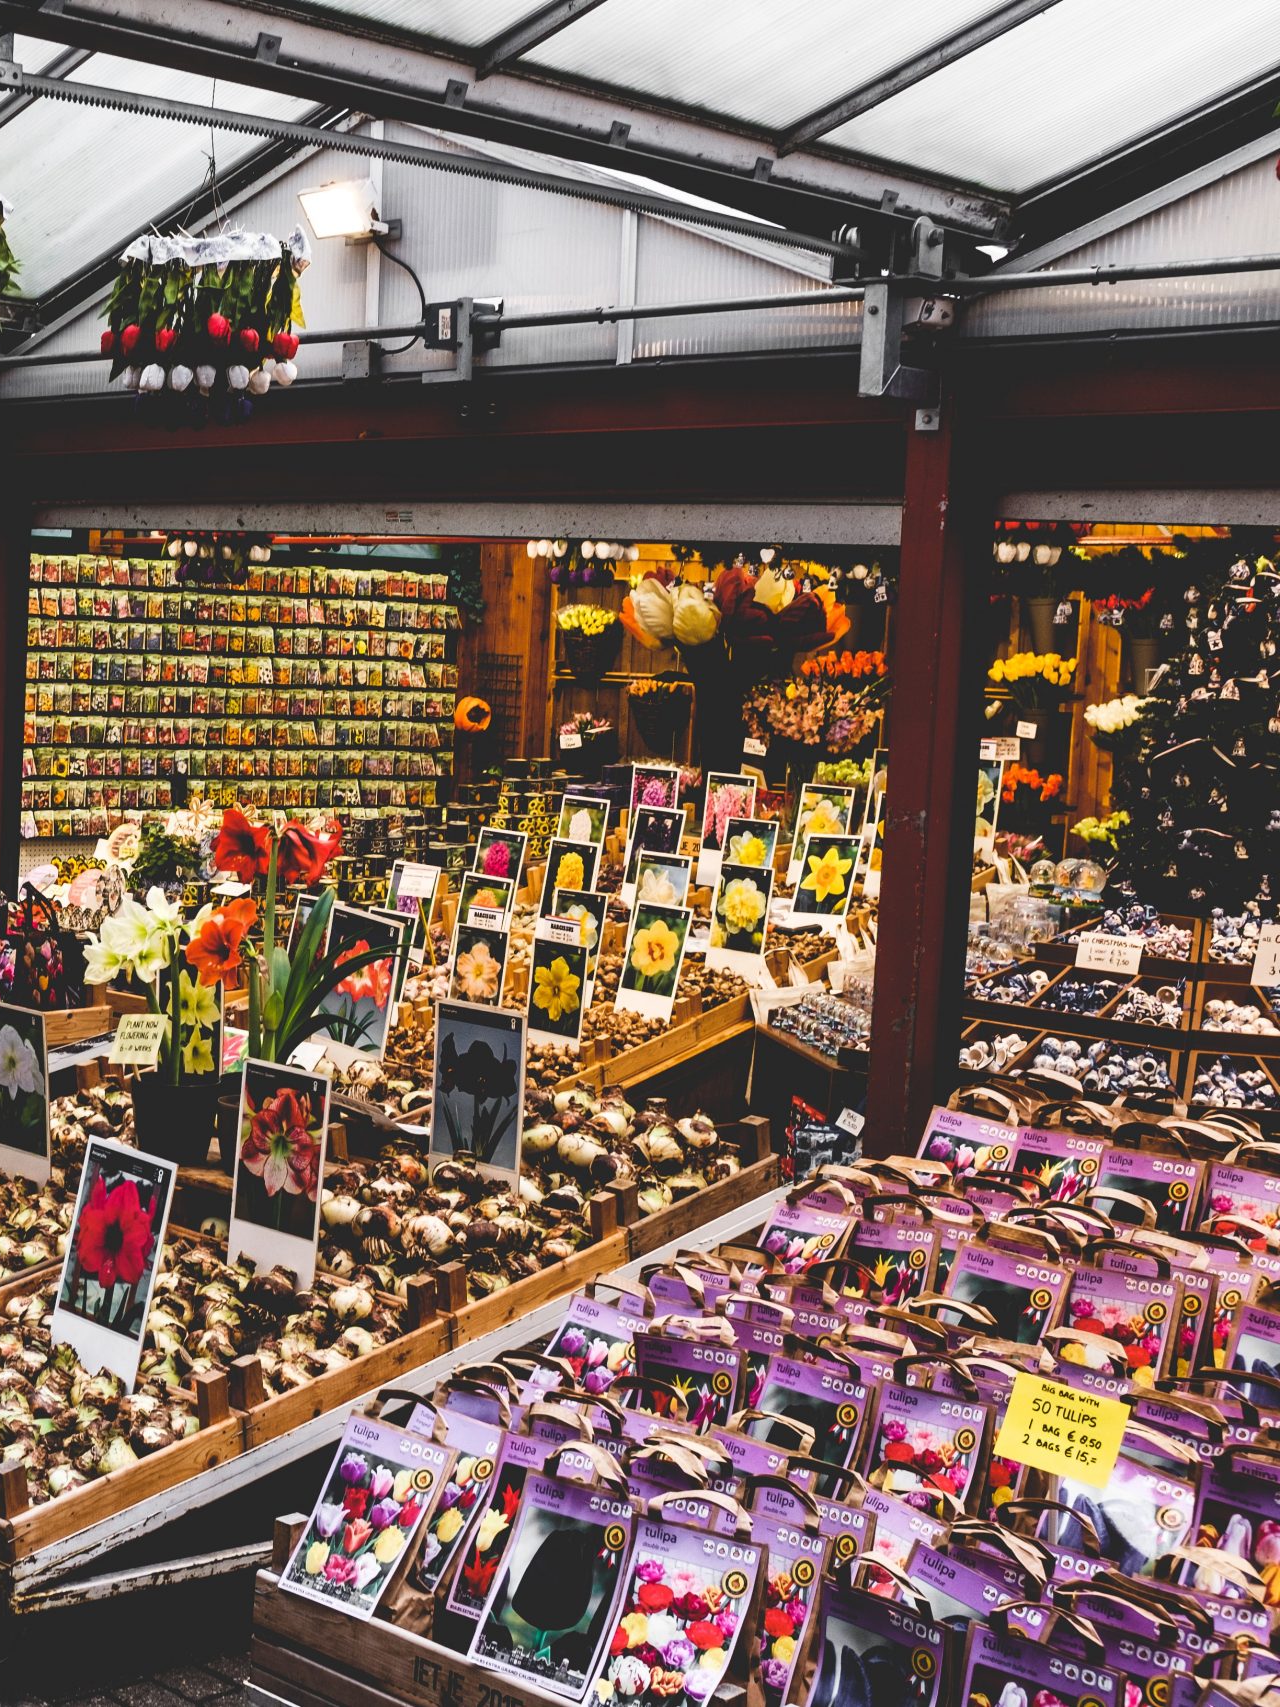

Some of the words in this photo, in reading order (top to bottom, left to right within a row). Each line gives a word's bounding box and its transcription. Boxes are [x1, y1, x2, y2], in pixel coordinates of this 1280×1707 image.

[126, 1020, 144, 1029] PLANT
[145, 1020, 159, 1029] NOW
[120, 1031, 150, 1040] FLOWERING
[939, 1114, 962, 1128] tulipa
[1024, 1132, 1048, 1143] tulipa
[1108, 1154, 1133, 1167] tulipa
[1217, 1168, 1244, 1183] tulipa
[778, 1208, 801, 1220] tulipa
[967, 1250, 994, 1267] tulipa
[1109, 1257, 1138, 1273] tulipa
[699, 1272, 723, 1286] tulipa
[576, 1303, 600, 1318] tulipa
[776, 1363, 801, 1378] tulipa
[888, 1389, 919, 1406] tulipa
[1059, 1390, 1075, 1401] BAG
[1032, 1398, 1051, 1414] 50
[1146, 1404, 1180, 1423] tulipa
[353, 1424, 380, 1441] tulipa
[540, 1427, 567, 1442] tulipa
[1028, 1418, 1033, 1430] 1
[1042, 1424, 1060, 1437] BAG
[1067, 1430, 1076, 1442] €
[510, 1441, 536, 1455] tulipa
[1022, 1434, 1030, 1445] 2
[1036, 1439, 1060, 1452] BAGS
[1064, 1446, 1074, 1458] €
[535, 1483, 565, 1500] tulipa
[766, 1491, 795, 1508] tulipa
[645, 1526, 677, 1544] tulipa
[923, 1553, 957, 1580] tulipa
[1086, 1600, 1124, 1622] tulipa
